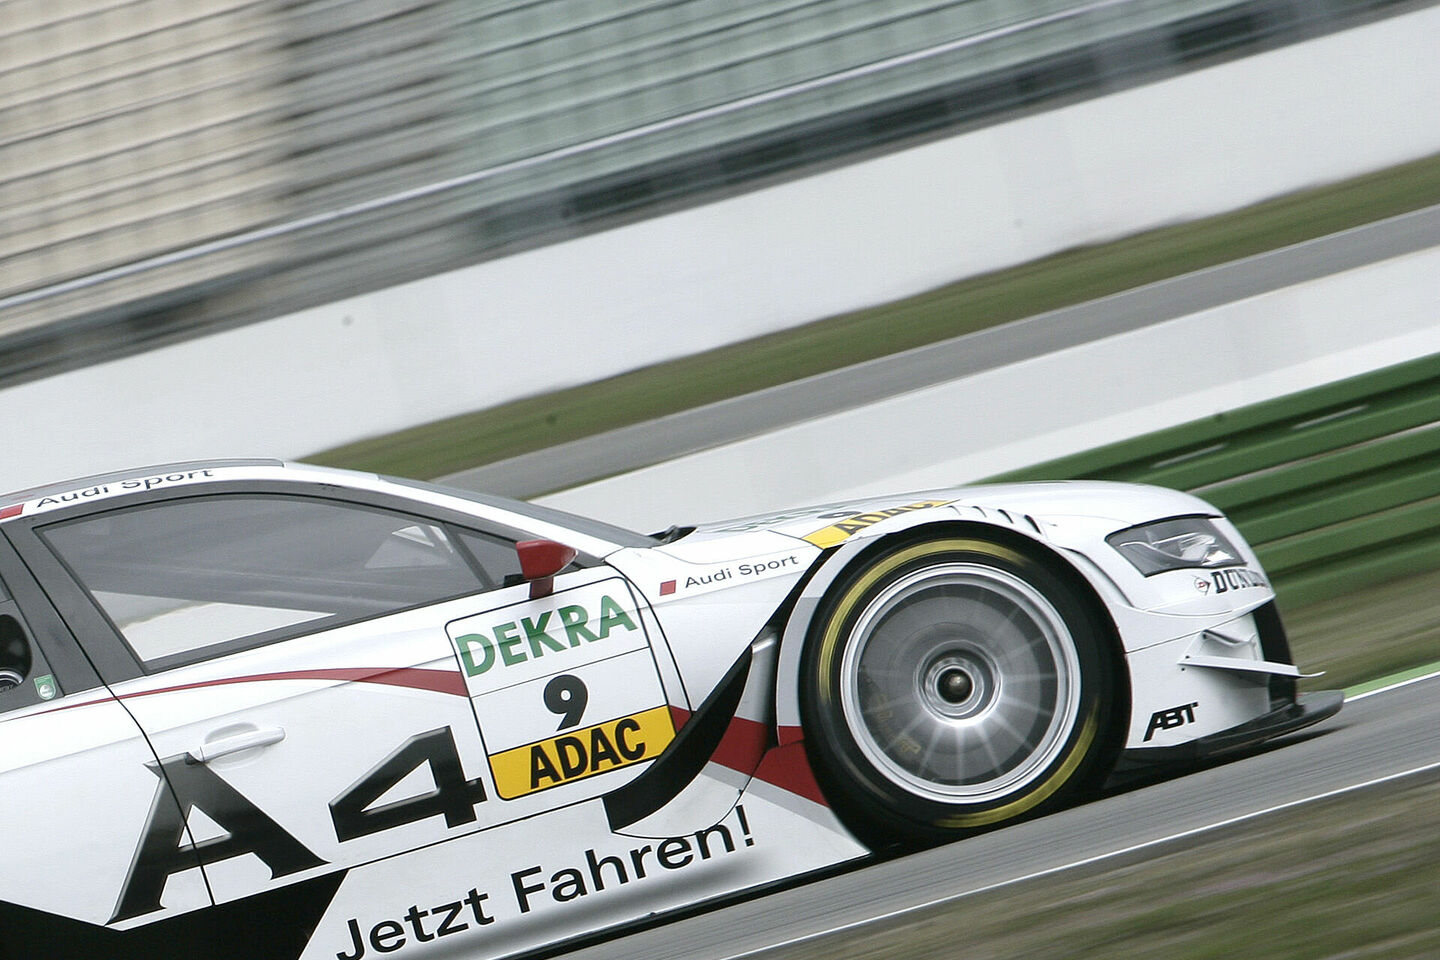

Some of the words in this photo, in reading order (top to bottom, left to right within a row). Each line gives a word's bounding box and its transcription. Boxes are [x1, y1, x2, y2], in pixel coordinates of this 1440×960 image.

[36, 484, 109, 508] Audi
[121, 468, 213, 490] Sport
[685, 567, 732, 588] Audi
[738, 555, 799, 575] Sport
[455, 595, 638, 678] DEKRA
[543, 674, 589, 732] 9
[1143, 701, 1199, 742] ABT
[530, 718, 646, 790] ADAC
[104, 725, 488, 927] A4
[511, 804, 756, 914] Fahren!
